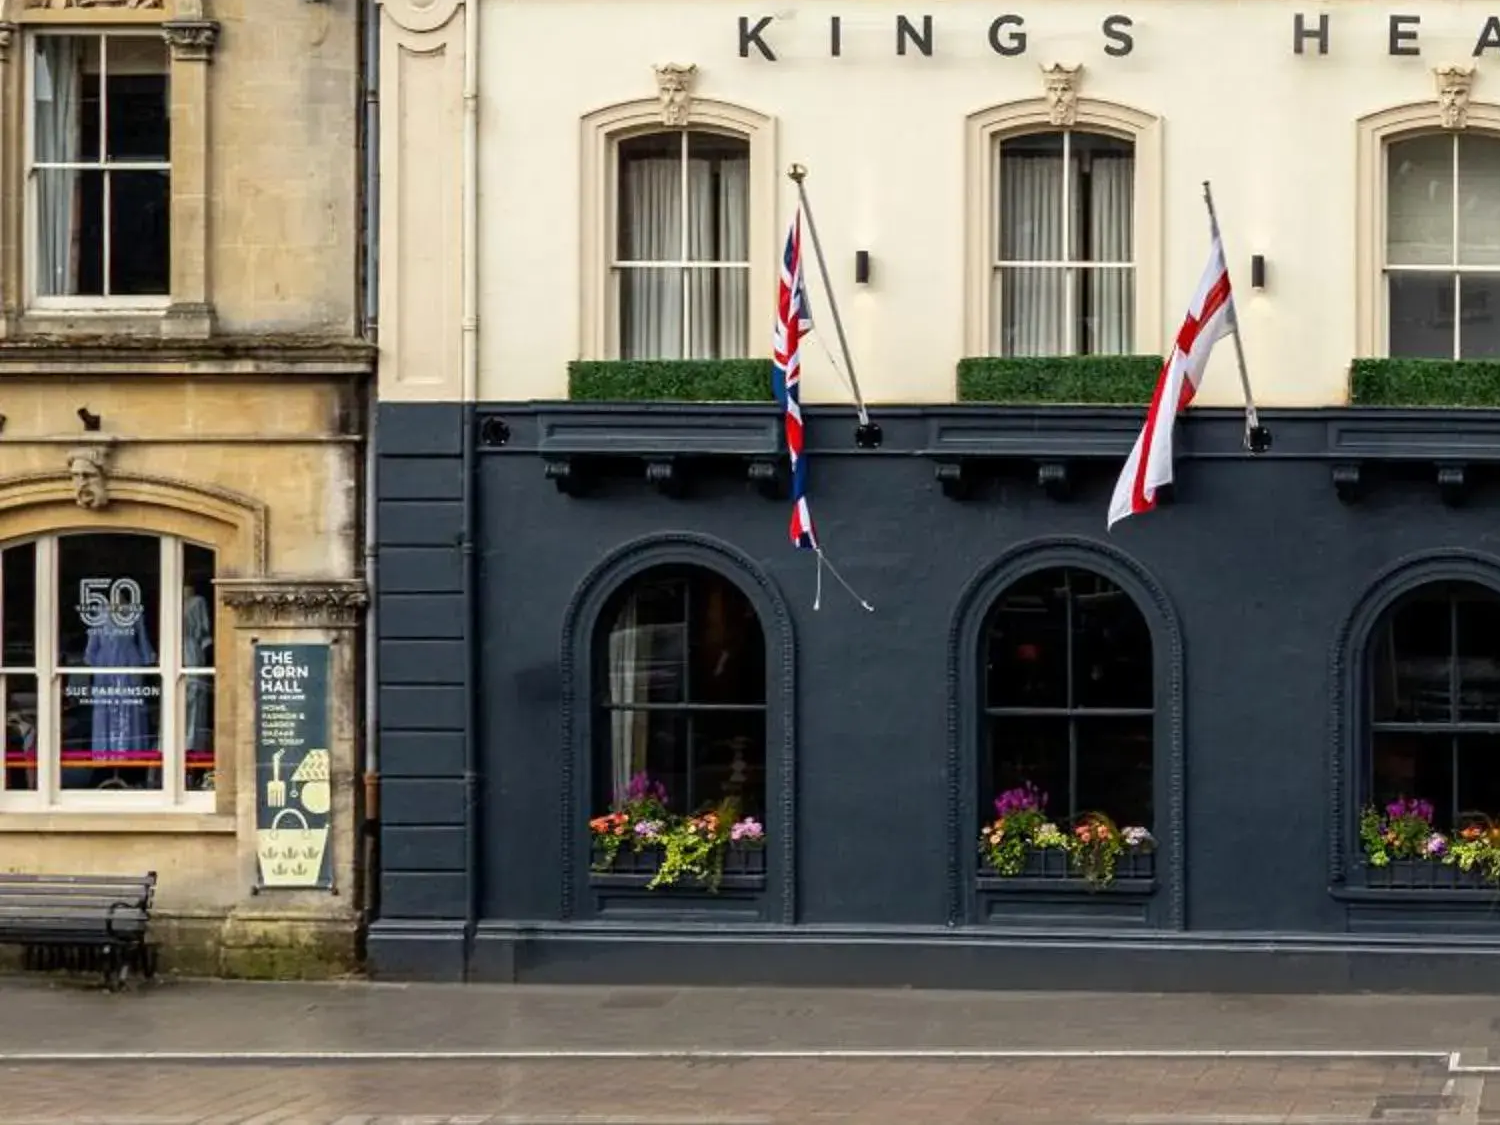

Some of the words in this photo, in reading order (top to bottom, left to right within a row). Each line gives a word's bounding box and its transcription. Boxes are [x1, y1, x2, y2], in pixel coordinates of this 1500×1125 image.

[739, 14, 1134, 62] KINGS
[80, 578, 142, 627] 50
[260, 650, 293, 664] THE
[261, 664, 309, 678] CORN
[65, 686, 88, 696] SUE
[92, 686, 160, 696] PARKINSON
[261, 679, 302, 693] HALL
